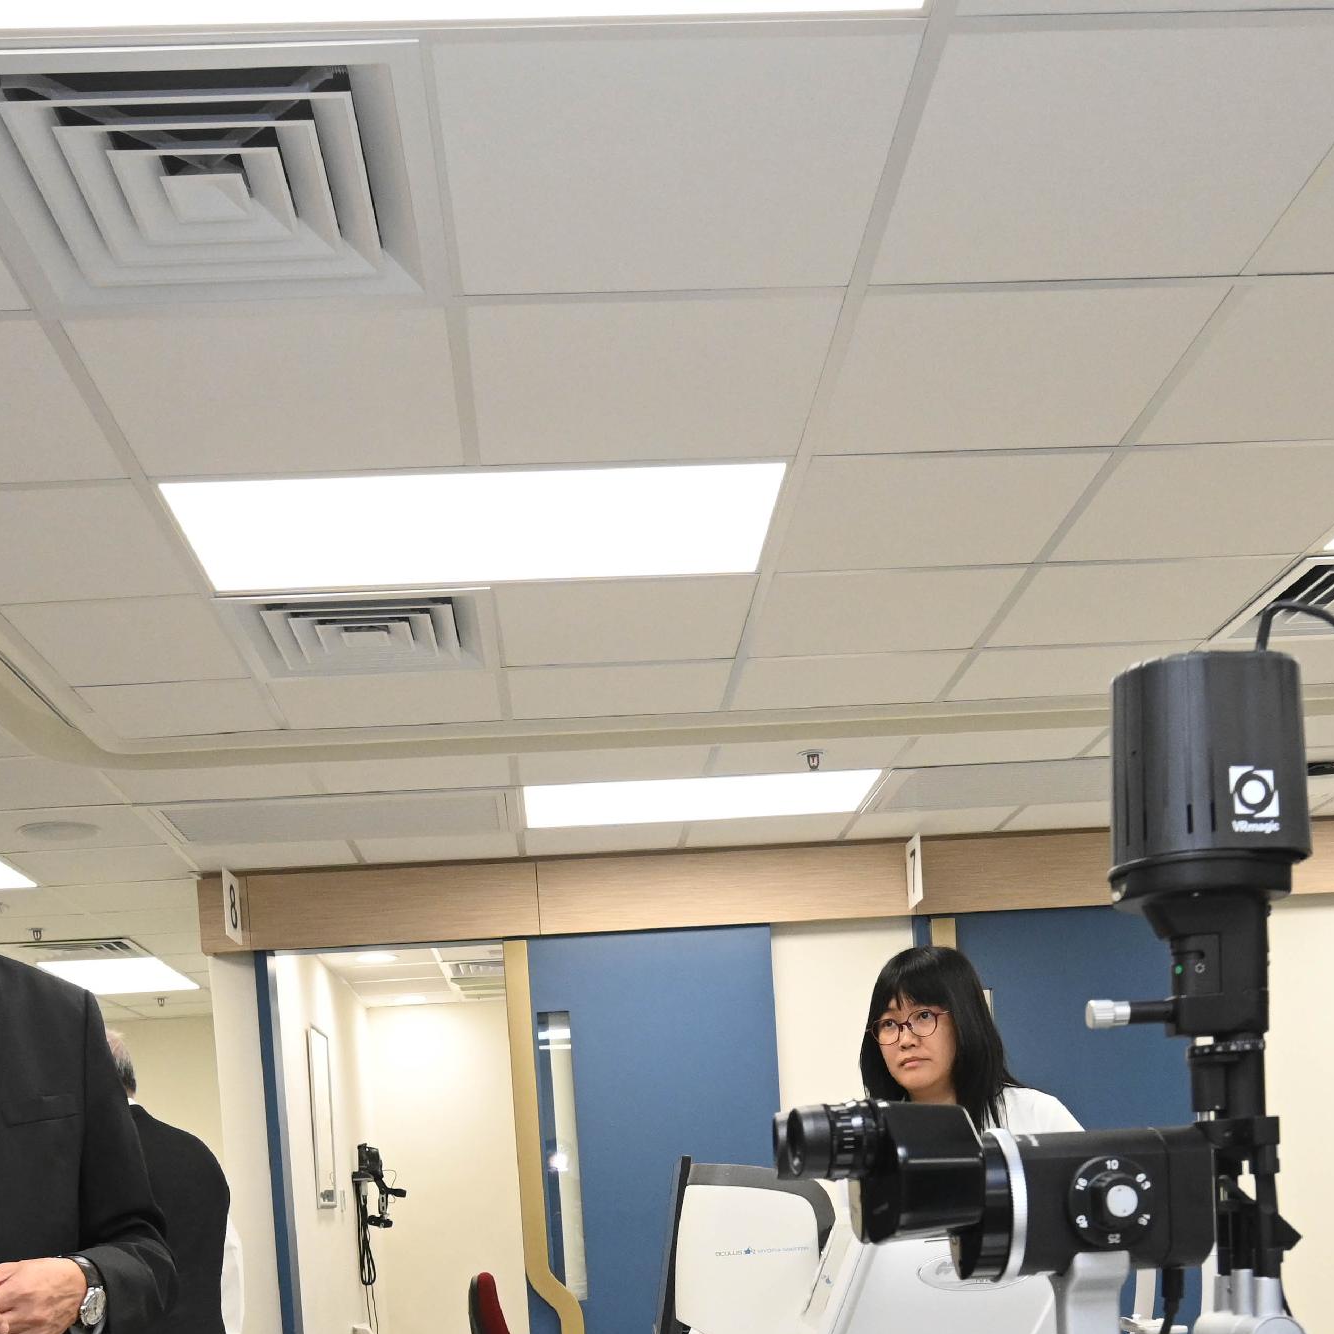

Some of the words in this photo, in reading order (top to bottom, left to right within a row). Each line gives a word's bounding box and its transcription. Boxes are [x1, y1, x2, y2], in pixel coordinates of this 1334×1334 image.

[1231, 819, 1280, 834] VRmagic
[229, 883, 238, 929] 8
[1105, 1159, 1119, 1170] 10
